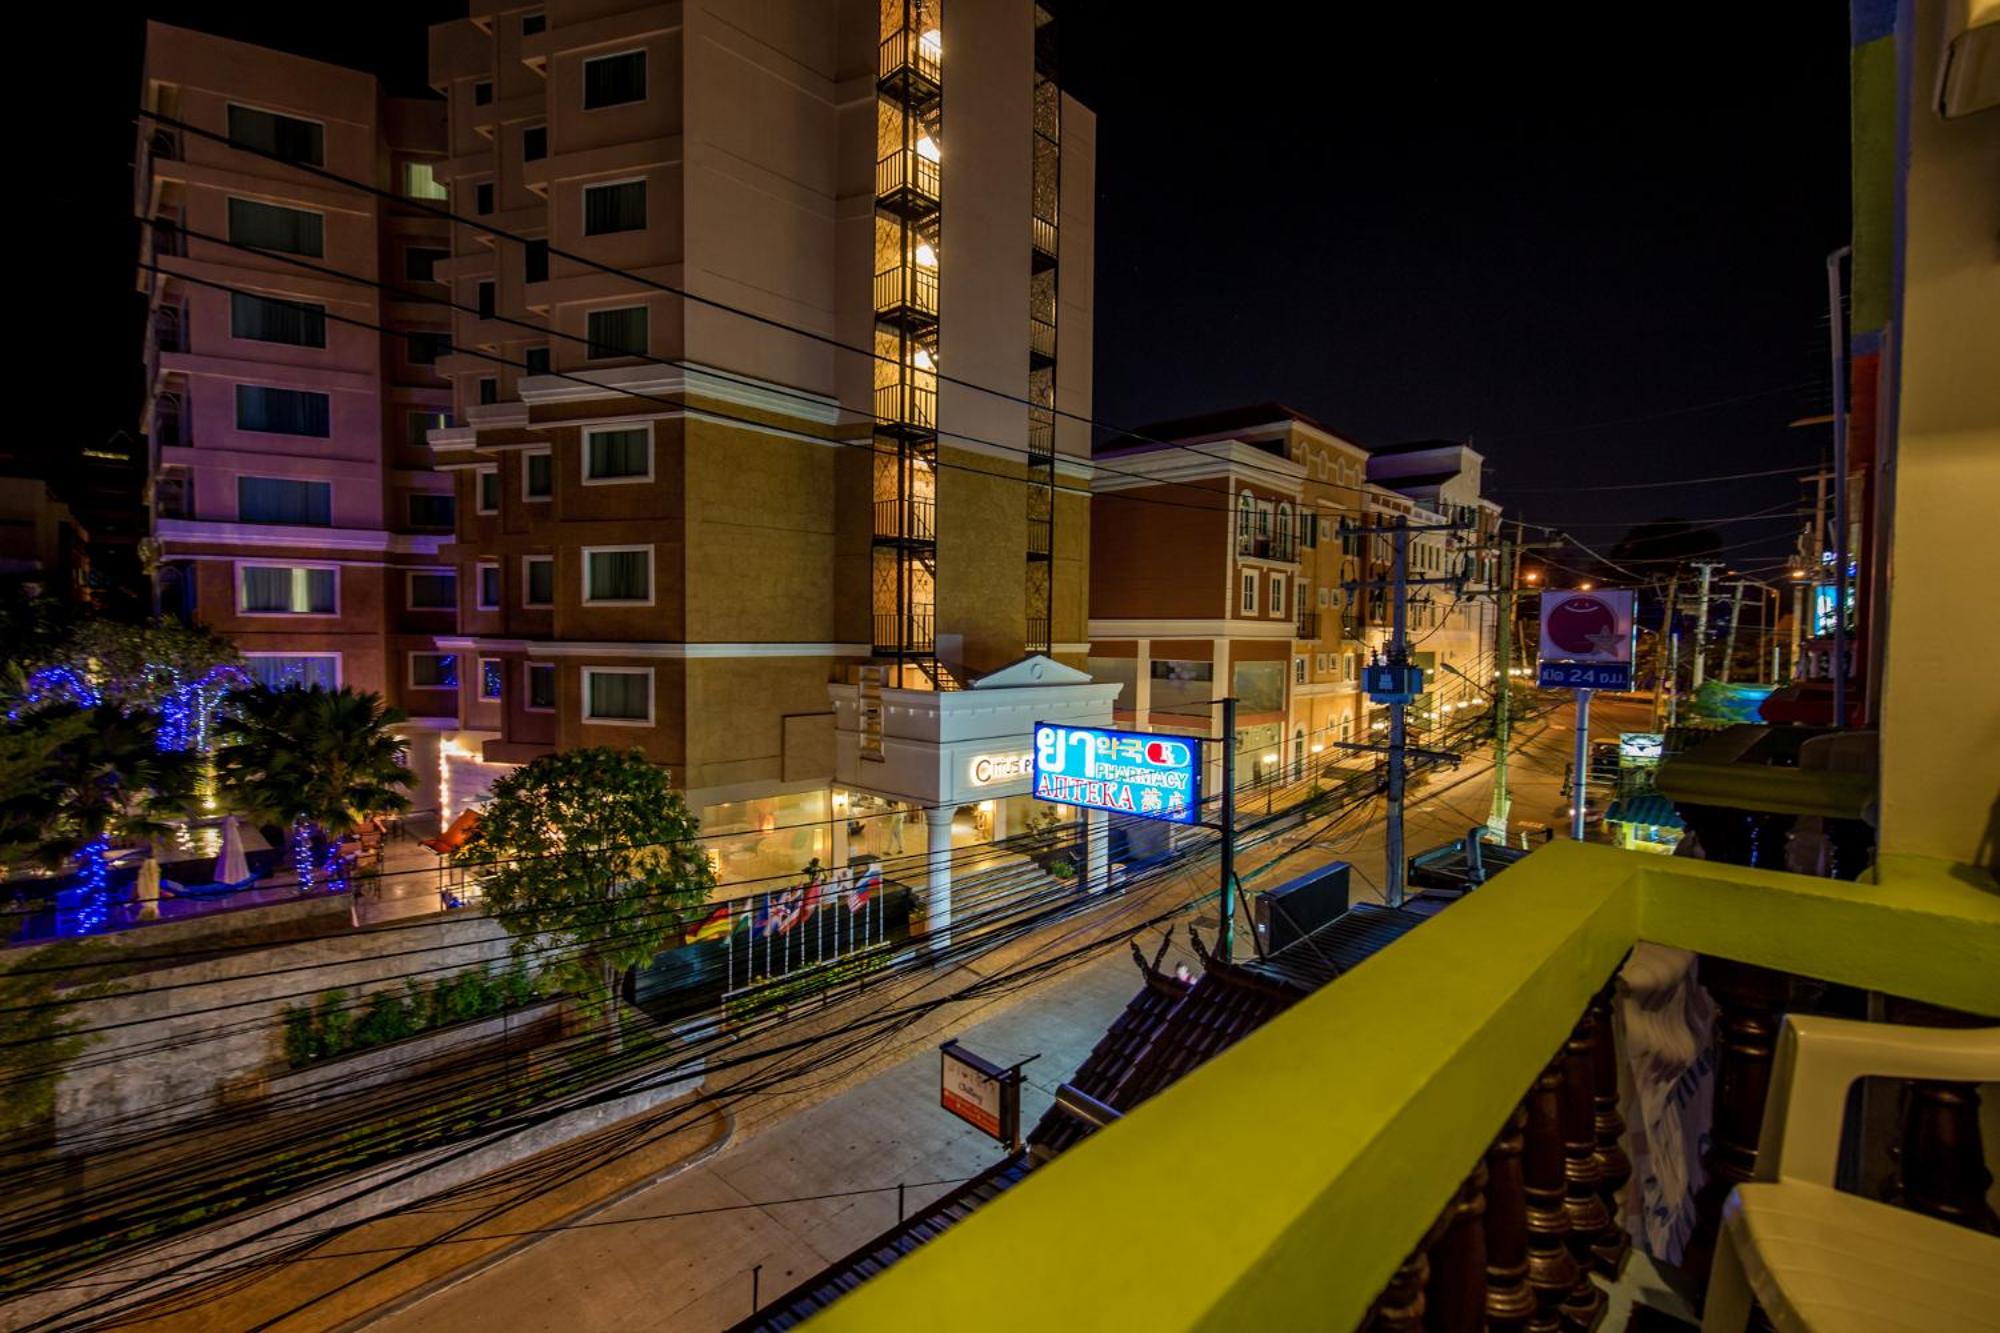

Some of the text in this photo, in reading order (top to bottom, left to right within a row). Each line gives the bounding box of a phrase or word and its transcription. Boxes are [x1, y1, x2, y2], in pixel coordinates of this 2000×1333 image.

[1569, 669, 1595, 683] 24
[1036, 727, 1096, 778] ยา
[1096, 736, 1144, 764] 약국
[1096, 762, 1188, 789] PHARMACY
[1035, 774, 1136, 811] АПТЕКА
